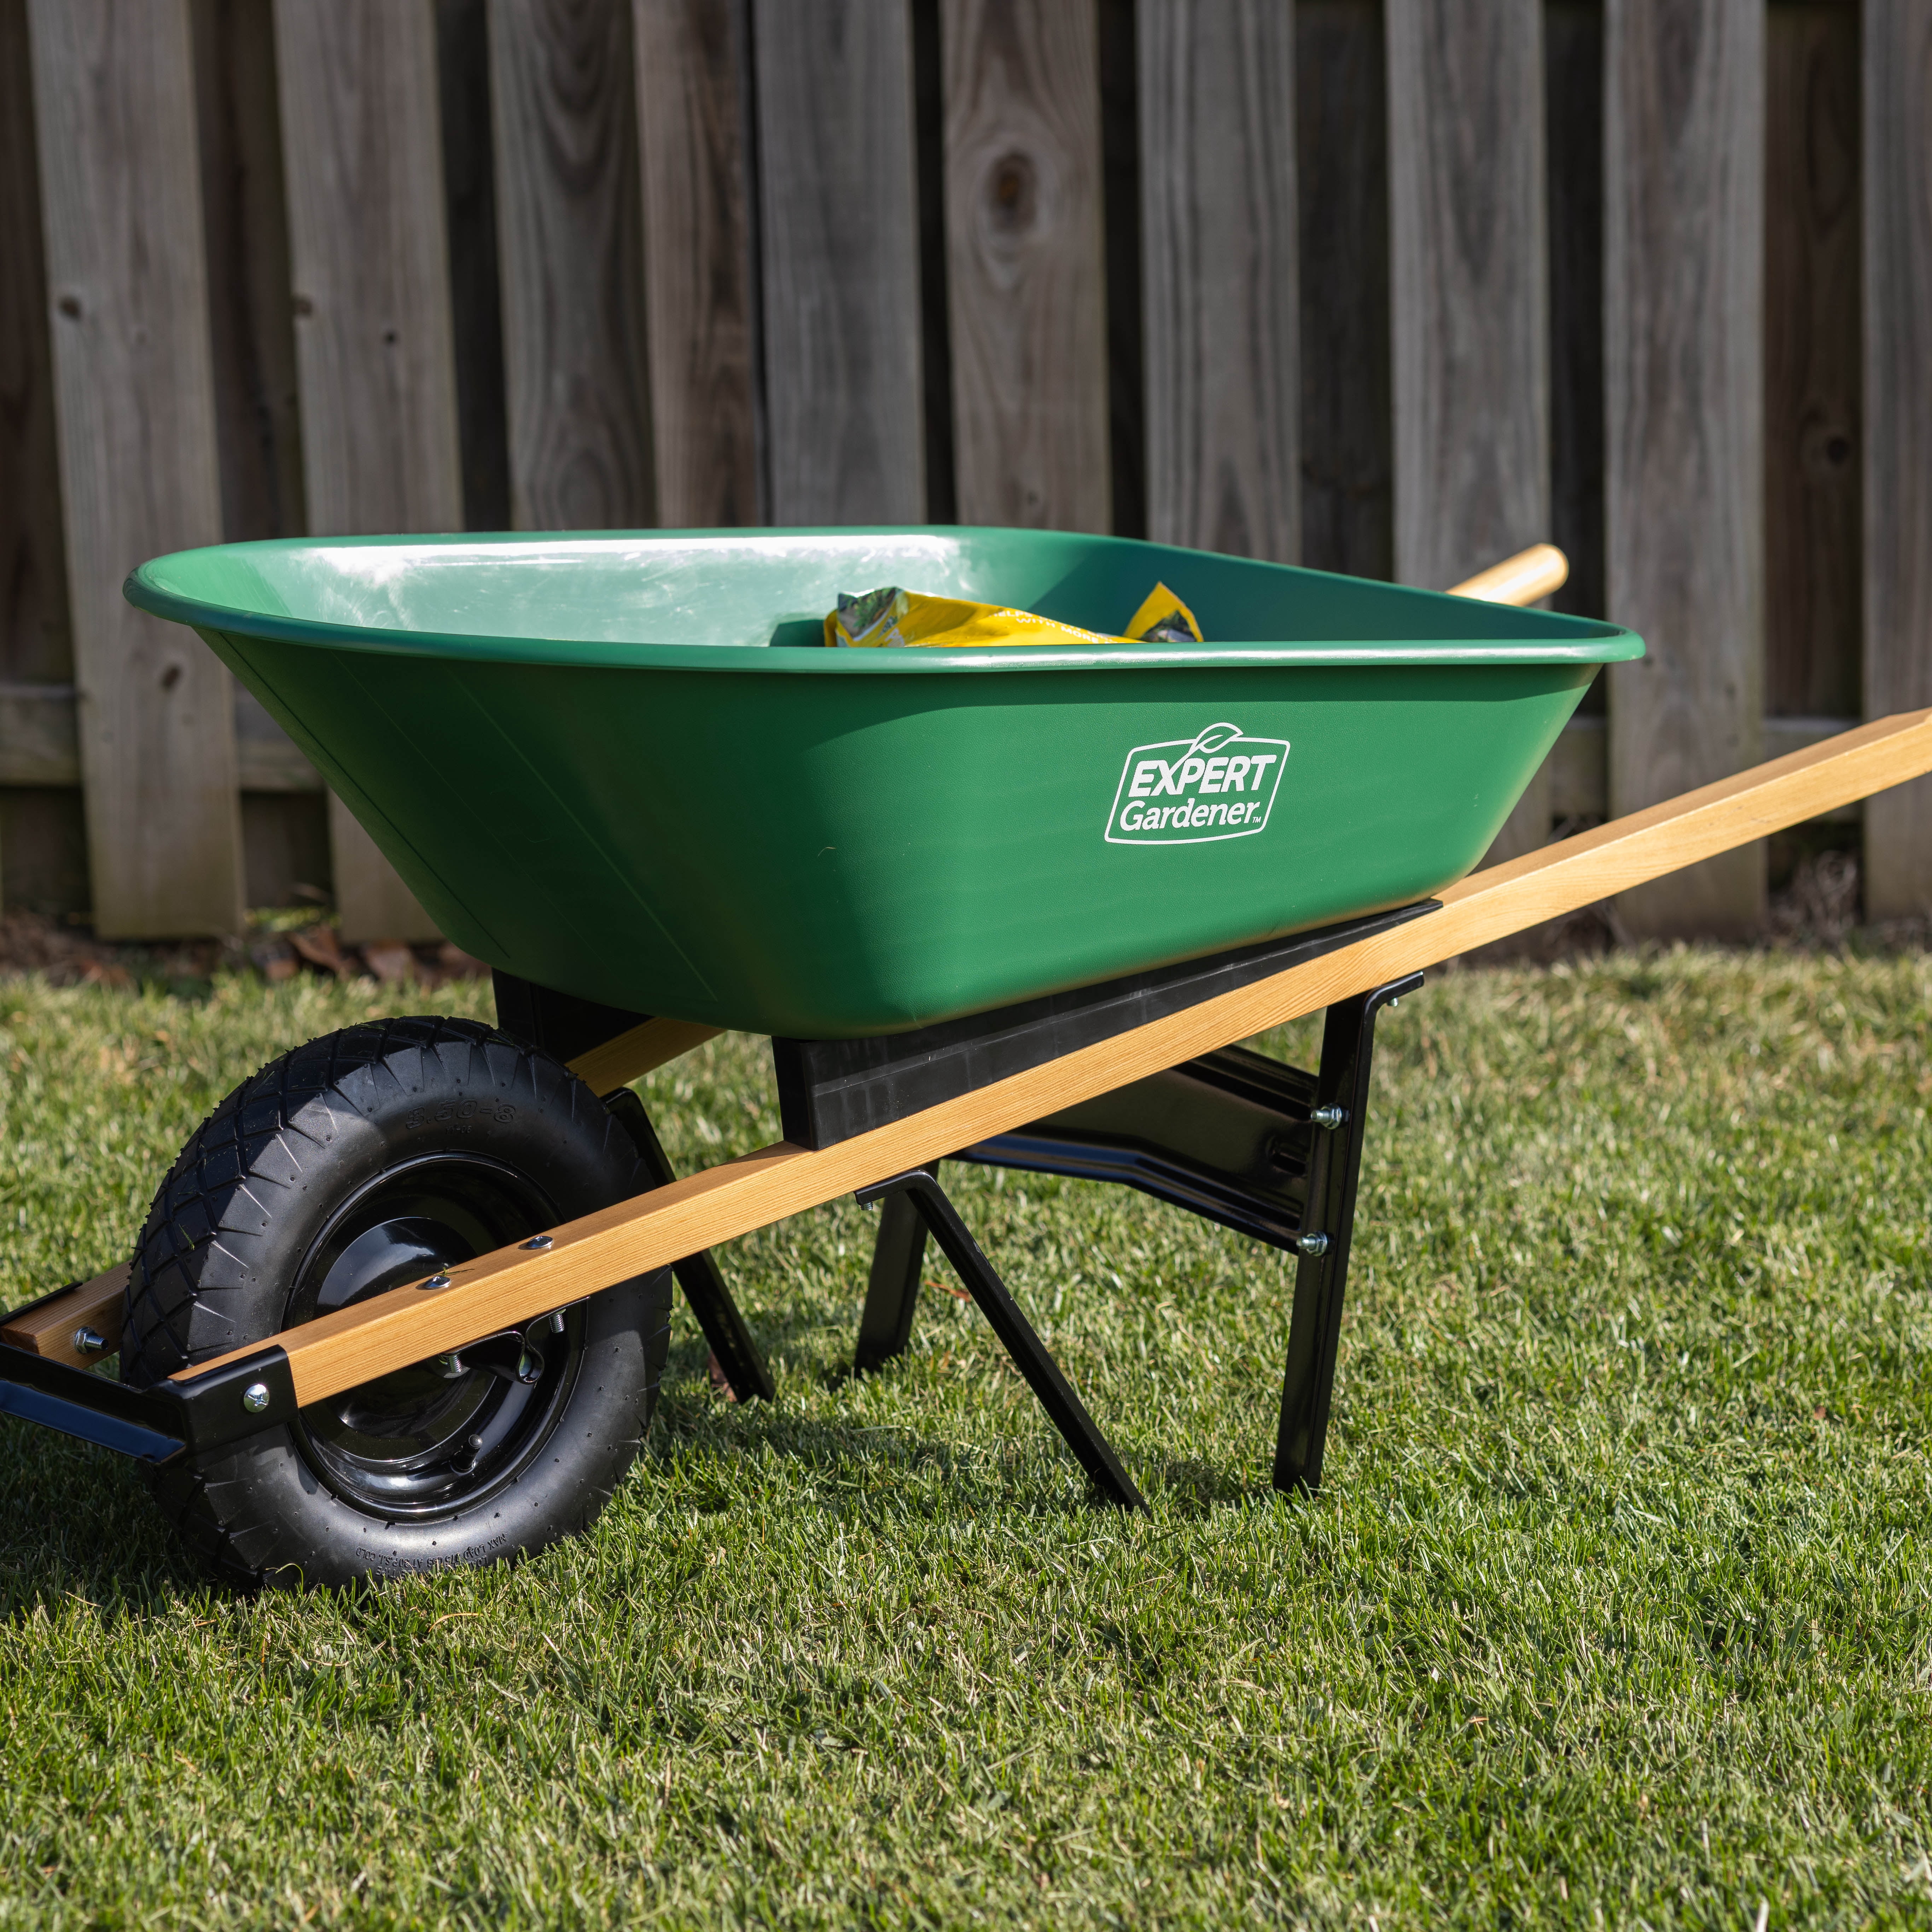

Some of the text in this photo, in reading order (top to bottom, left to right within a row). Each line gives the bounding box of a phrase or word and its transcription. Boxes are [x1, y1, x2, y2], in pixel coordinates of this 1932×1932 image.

[1016, 618, 1055, 628] WITH
[1061, 625, 1099, 644] MORE
[1128, 755, 1277, 797] EXPERT
[1120, 798, 1261, 831] Gardener
[406, 1099, 516, 1129] 3.50-8
[487, 1533, 507, 1550] MAX
[356, 1546, 376, 1561] COLD
[463, 1543, 485, 1560] LOAD
[412, 1558, 423, 1569] AT
[375, 1566, 396, 1579] TYPE
